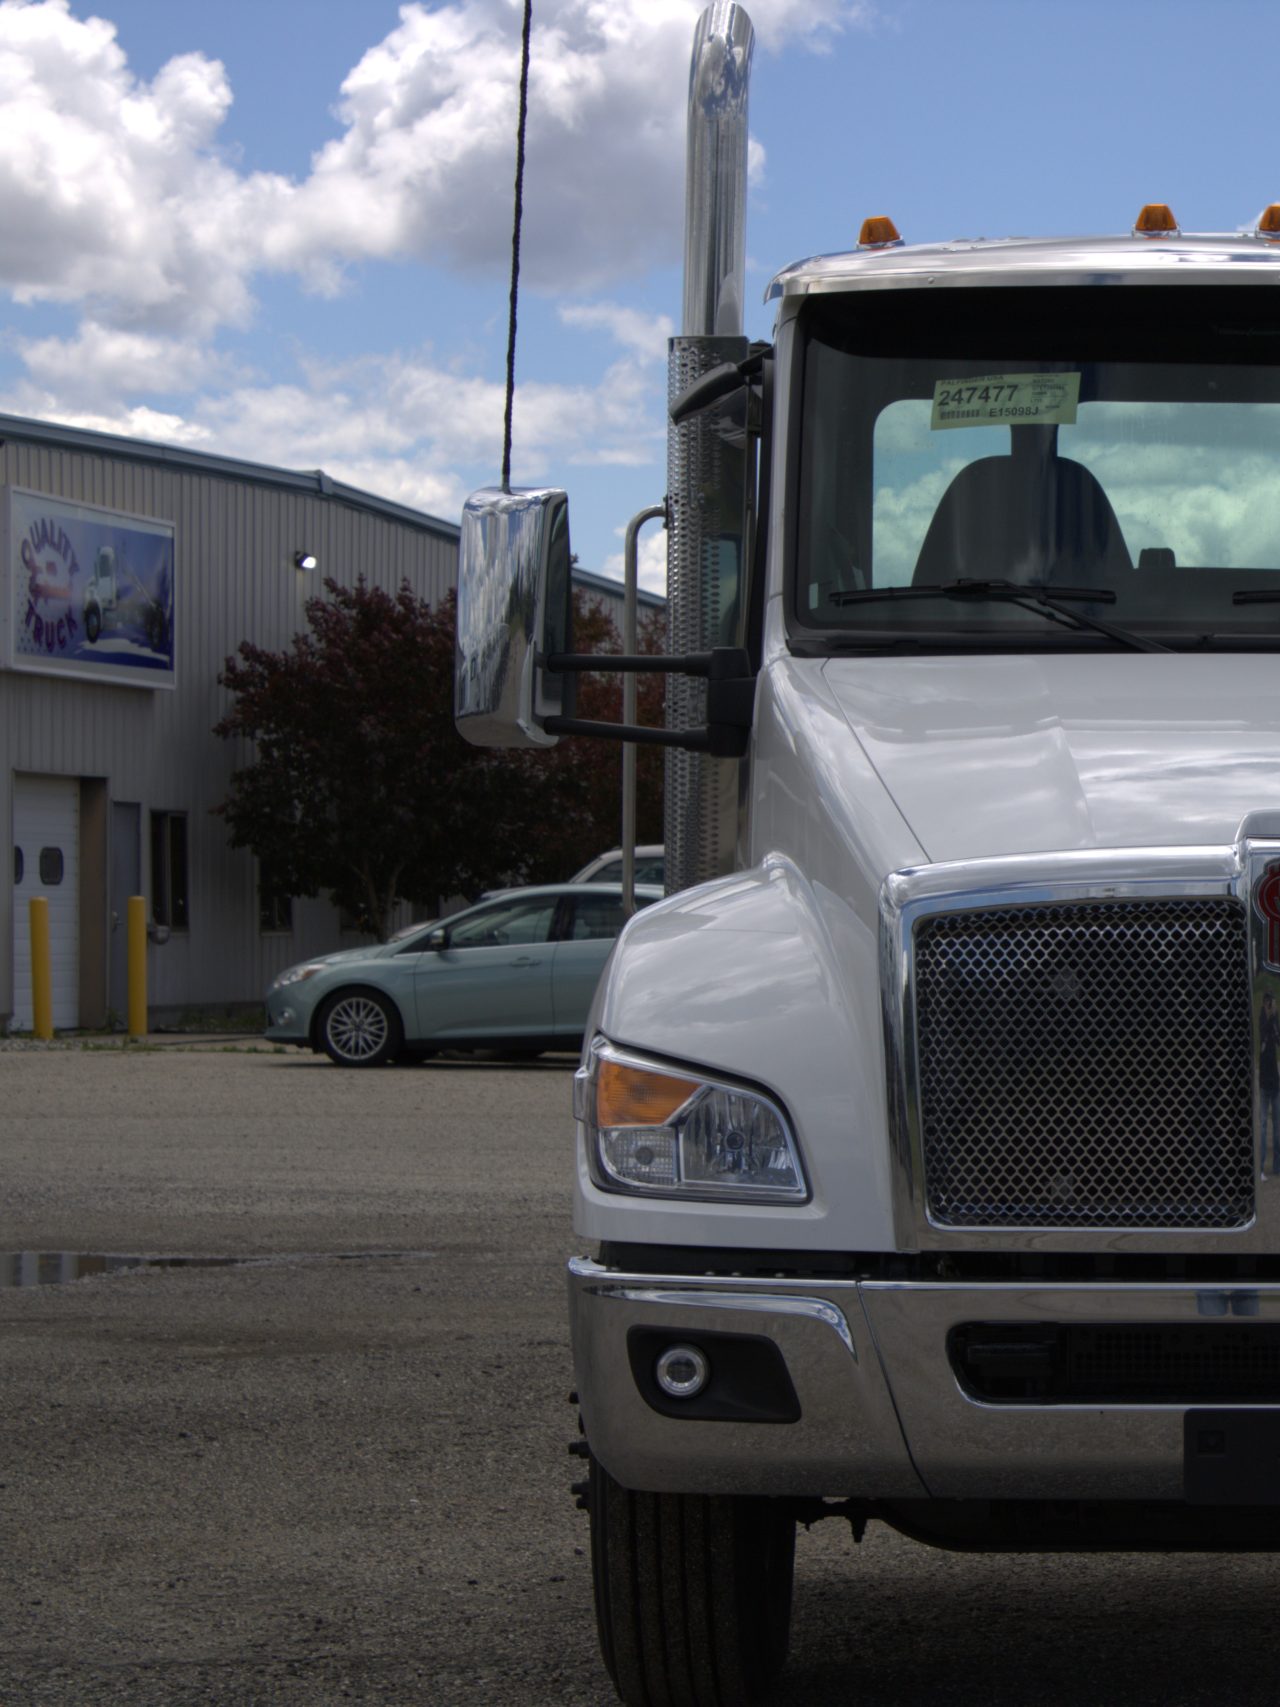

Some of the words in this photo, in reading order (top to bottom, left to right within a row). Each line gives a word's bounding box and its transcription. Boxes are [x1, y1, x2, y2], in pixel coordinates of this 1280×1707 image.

[937, 384, 1019, 407] 247477
[989, 406, 1039, 418] E15098J
[21, 517, 80, 575] QUALITY
[25, 597, 78, 653] TRUCK
